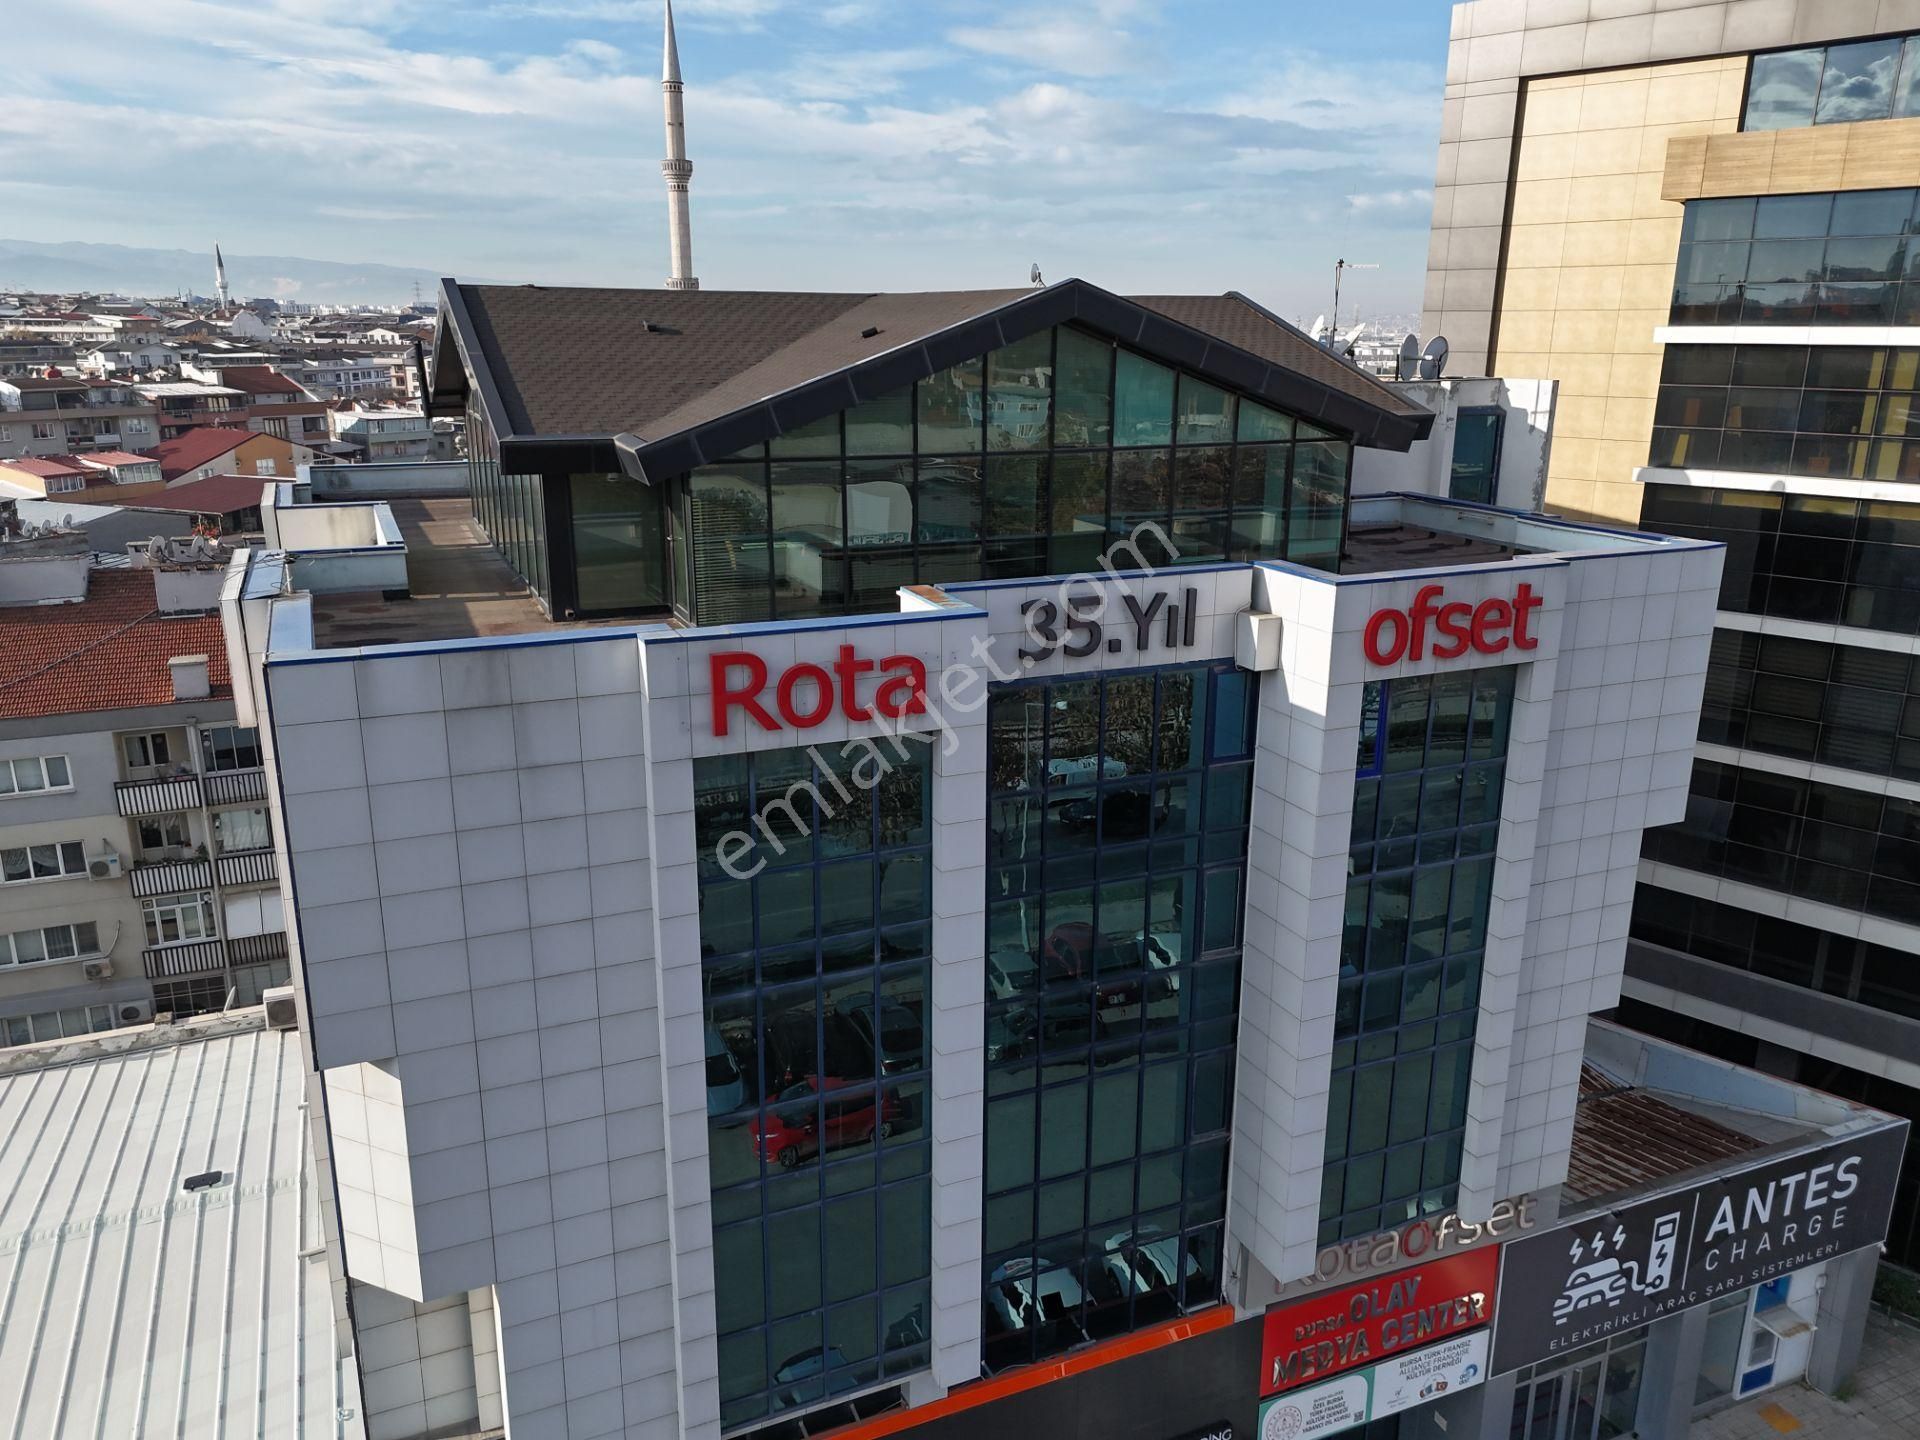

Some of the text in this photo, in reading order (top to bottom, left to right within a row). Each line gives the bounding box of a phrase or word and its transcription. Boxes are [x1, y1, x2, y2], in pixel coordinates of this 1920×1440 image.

[1363, 582, 1544, 667] ofset
[709, 643, 928, 738] Rota
[1704, 1155, 1863, 1243] ANTES
[1704, 1205, 1848, 1272] CHARGE
[1274, 1192, 1537, 1295] otaOfset
[1349, 1274, 1423, 1324] OLAY
[1550, 1239, 1840, 1350] ELEKTRİKLİ ARAÇ ŞARJ SİSTEMLERİ
[1272, 1291, 1486, 1388] MEDYA CENTER
[1399, 1355, 1422, 1369] BURSA
[1199, 1428, 1233, 1440] ING
